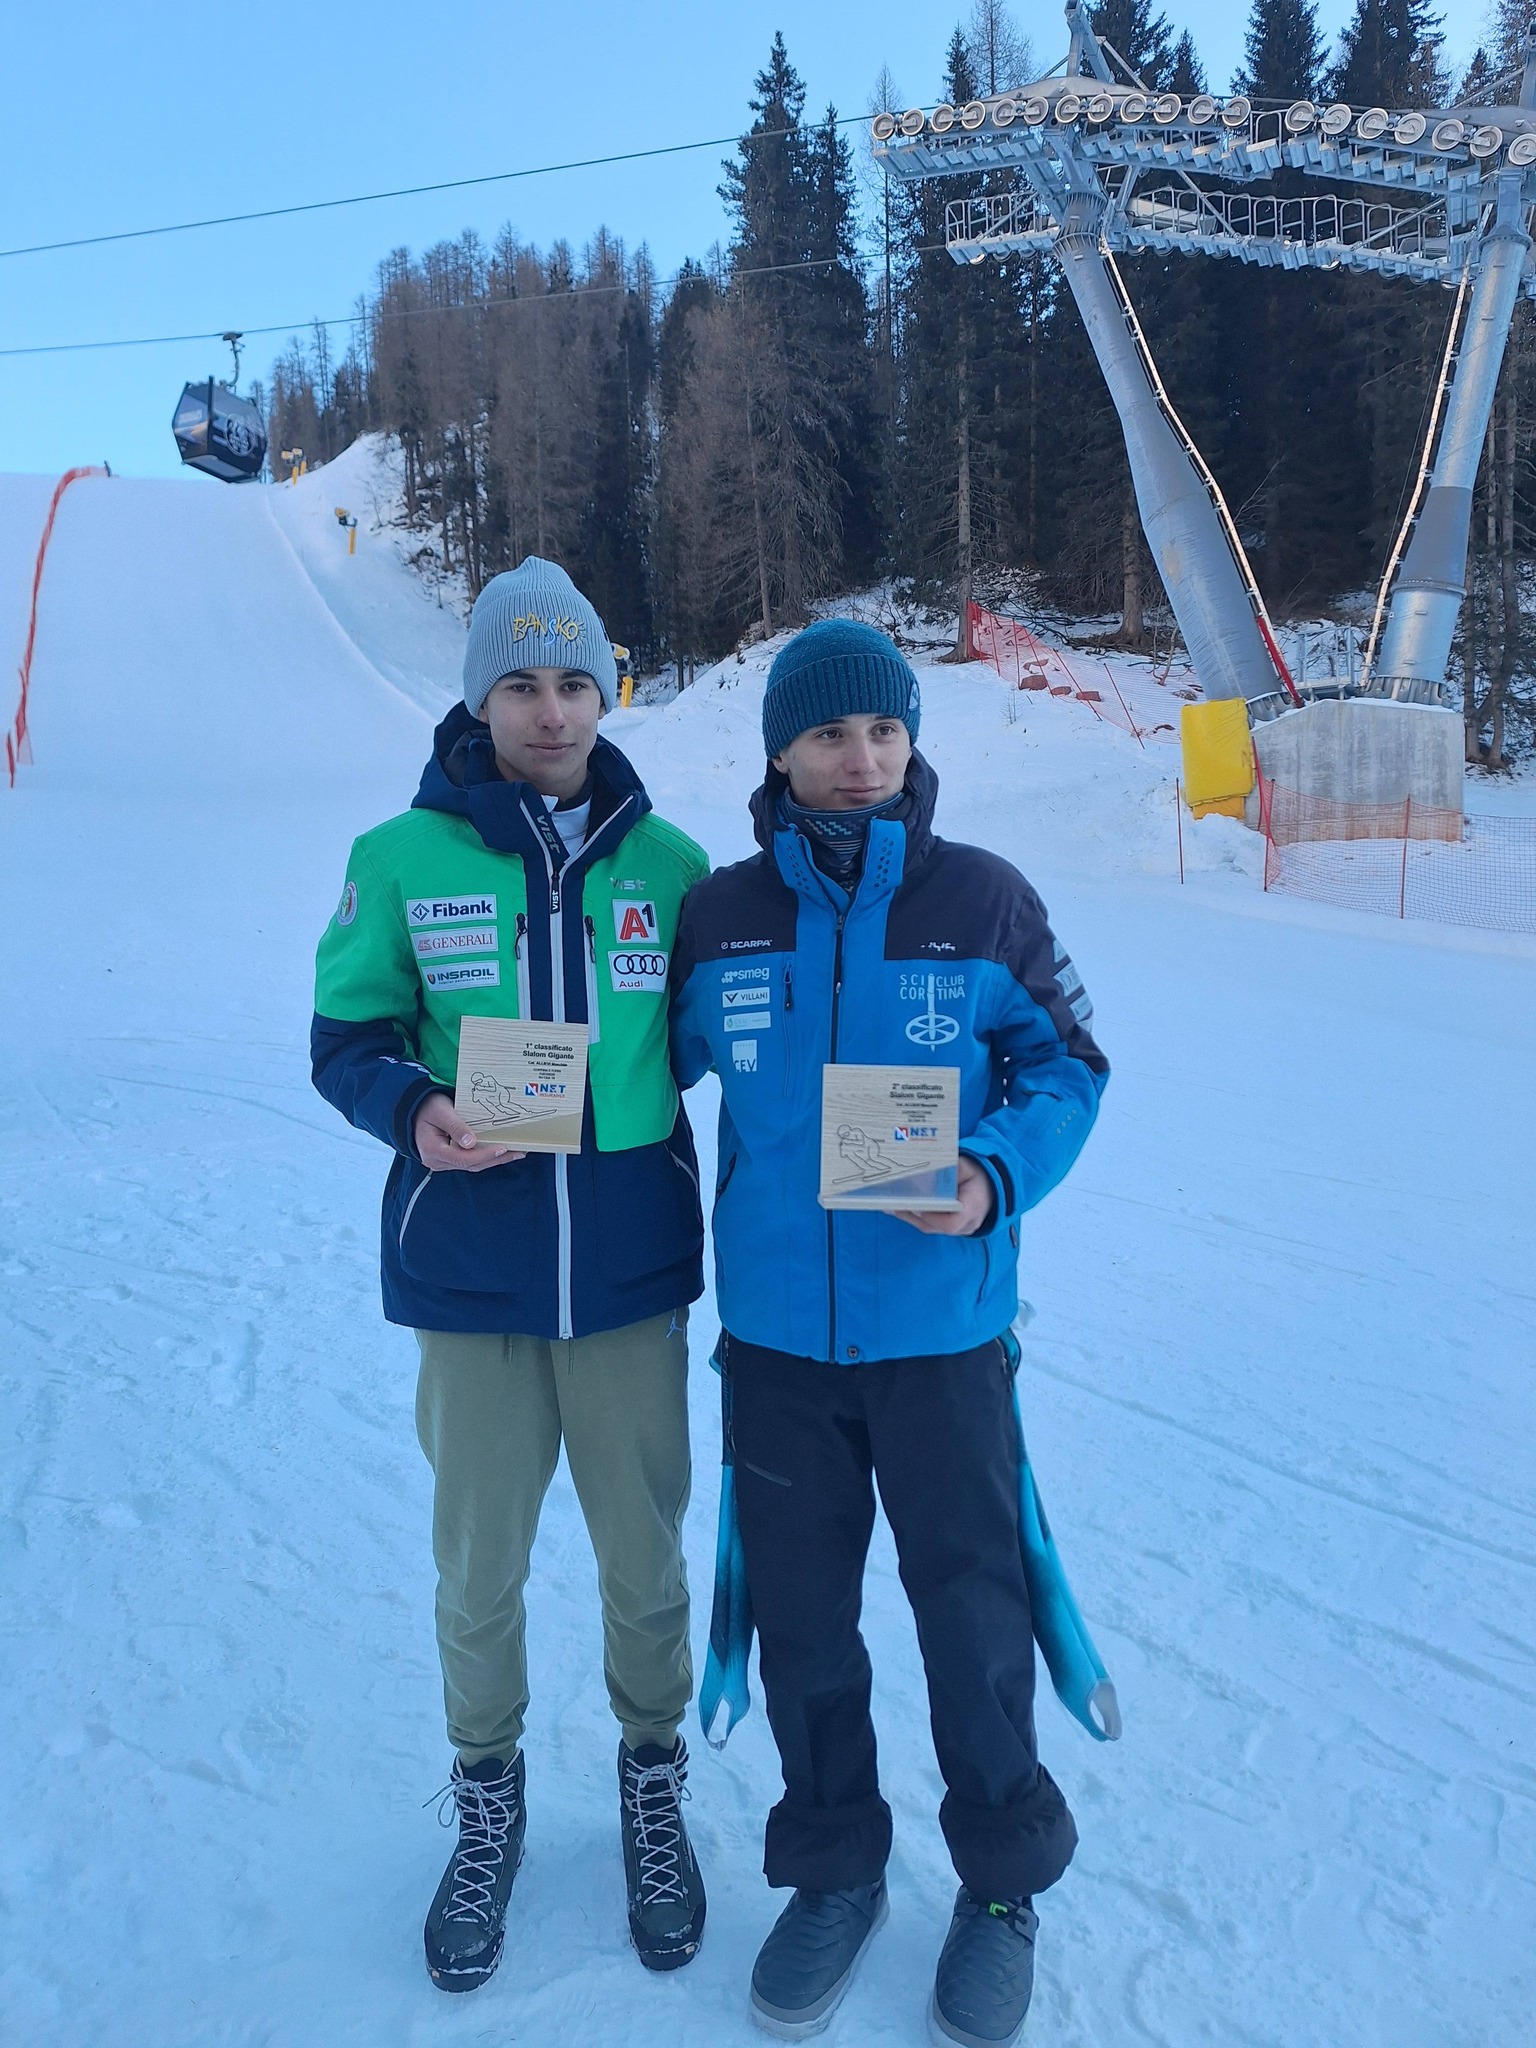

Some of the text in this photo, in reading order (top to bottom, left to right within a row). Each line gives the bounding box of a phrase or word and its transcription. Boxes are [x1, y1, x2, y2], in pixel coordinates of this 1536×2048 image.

[513, 612, 579, 646] BANSKO
[432, 900, 493, 918] Fibank
[620, 903, 655, 941] A1
[432, 933, 494, 950] GENERALI
[730, 940, 771, 949] SCARPA
[437, 968, 495, 981] INSAOIL
[737, 967, 770, 981] smeg
[618, 980, 644, 988] Audi
[900, 974, 965, 988] SCI CLUB
[741, 992, 768, 1001] VILLANI
[534, 1043, 573, 1052] classificato
[522, 1050, 575, 1060] Slalom Gigante
[540, 1083, 567, 1094] NET
[910, 1126, 938, 1137] NET
